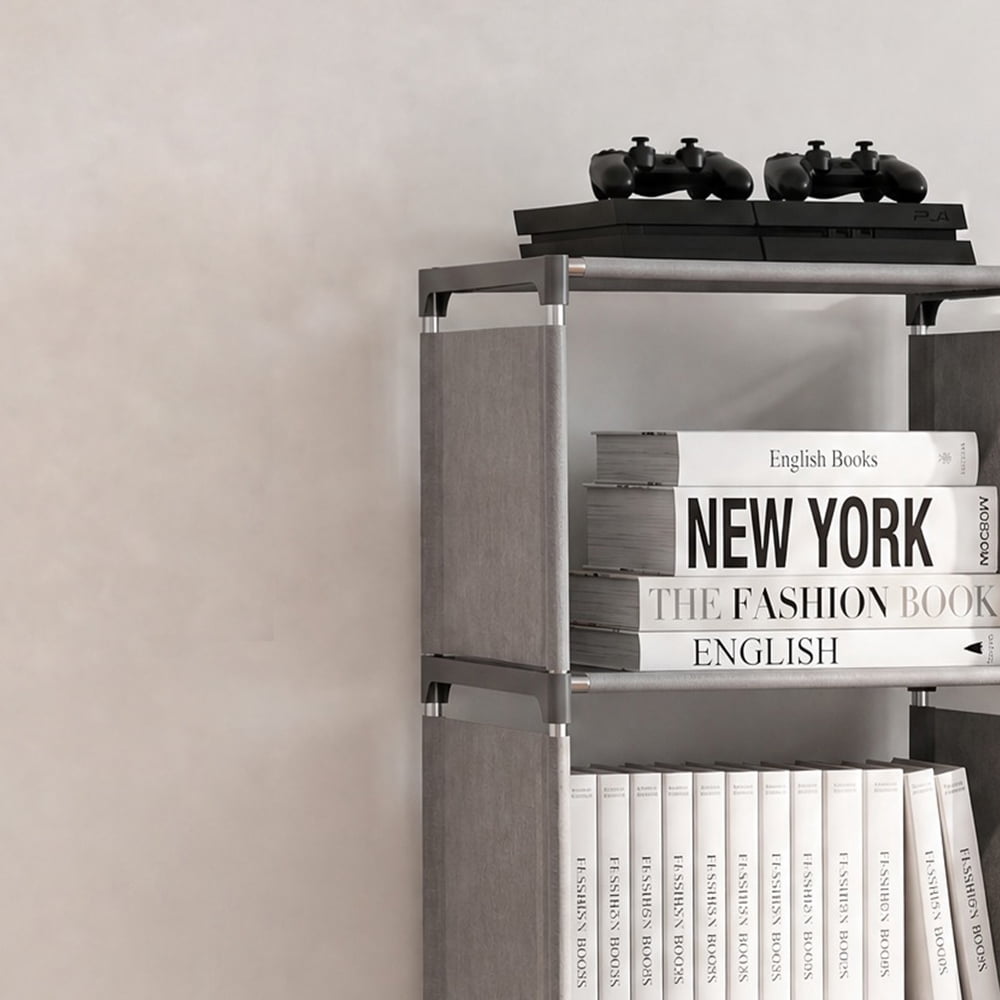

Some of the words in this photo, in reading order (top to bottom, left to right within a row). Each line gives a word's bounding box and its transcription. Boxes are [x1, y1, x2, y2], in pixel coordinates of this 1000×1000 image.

[769, 449, 826, 474] English
[831, 449, 878, 468] Books
[687, 497, 794, 569] NEW
[807, 495, 934, 569] YORK
[648, 587, 722, 621] THE
[733, 586, 888, 620] FASHION
[900, 584, 999, 620] BOOK
[693, 637, 838, 667] ENGLISH
